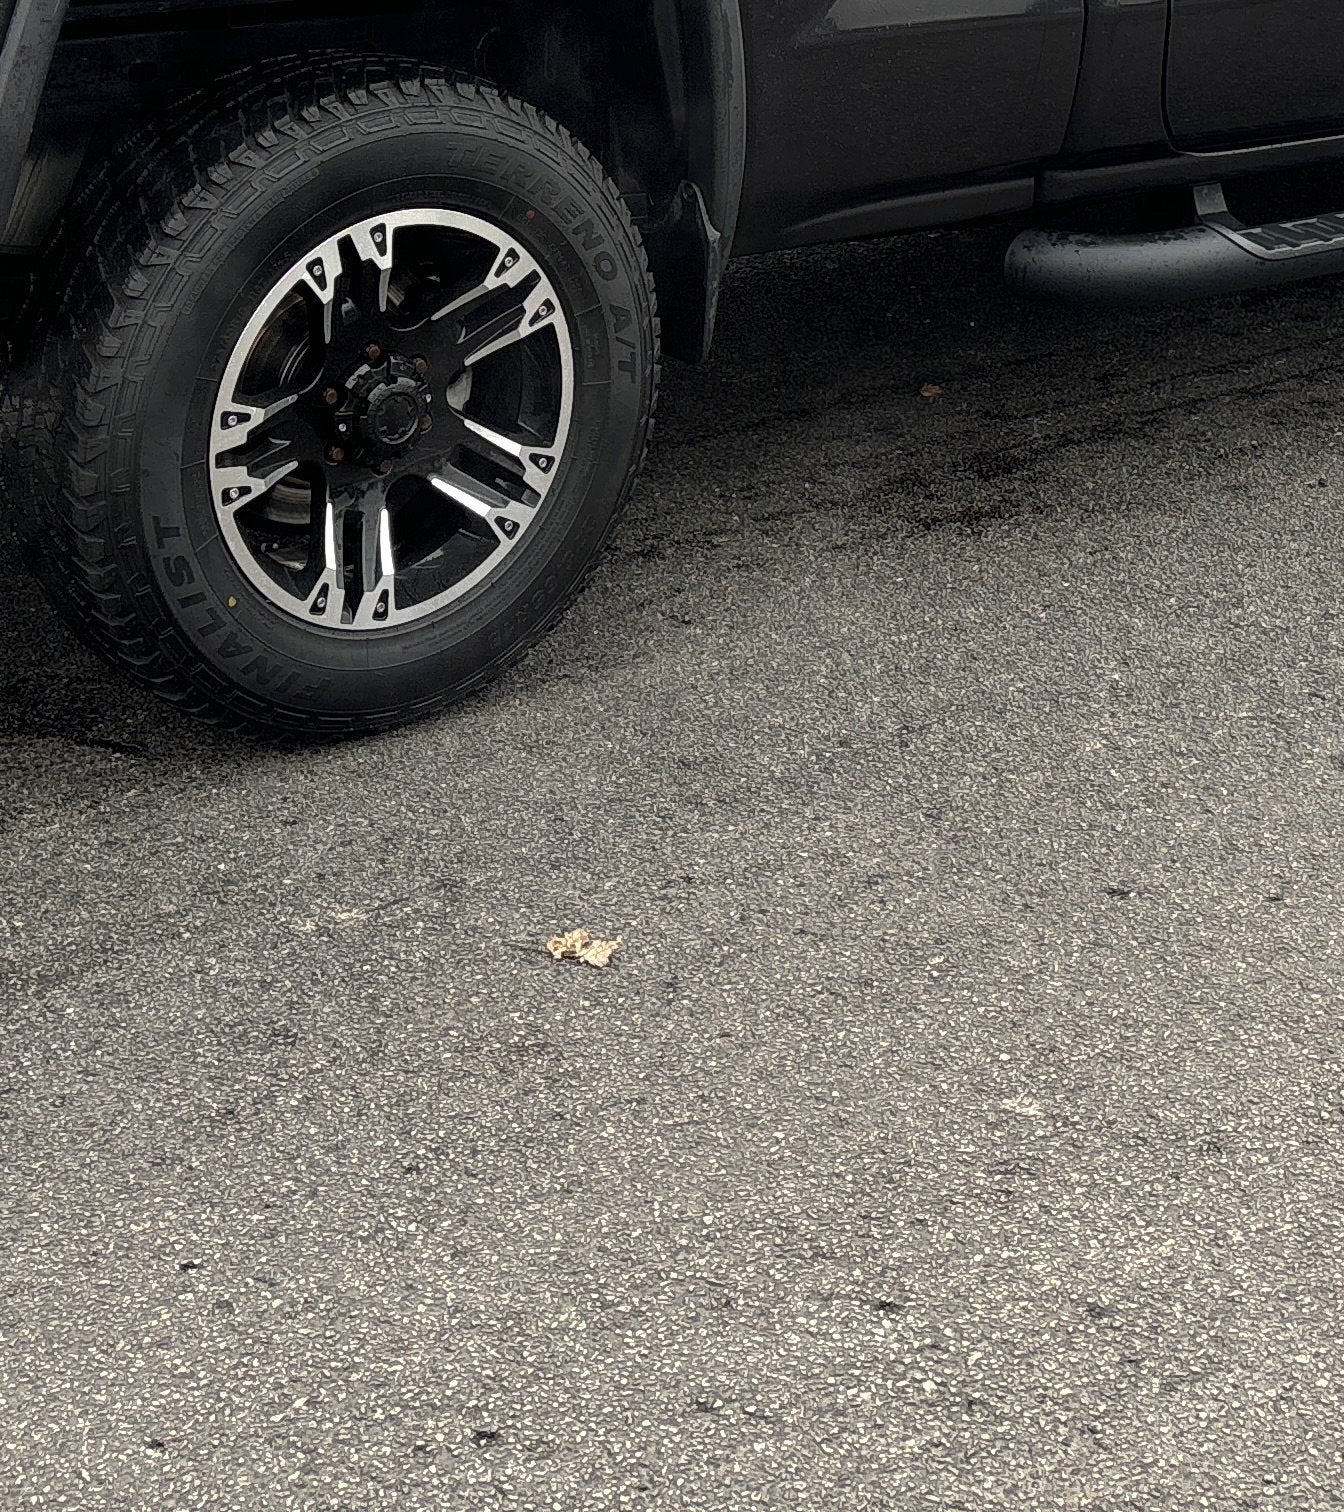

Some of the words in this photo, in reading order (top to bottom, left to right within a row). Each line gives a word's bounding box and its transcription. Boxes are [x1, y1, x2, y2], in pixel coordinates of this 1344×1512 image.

[447, 141, 619, 281] TERRENO
[609, 303, 637, 384] A/T
[152, 514, 332, 703] FINALIST
